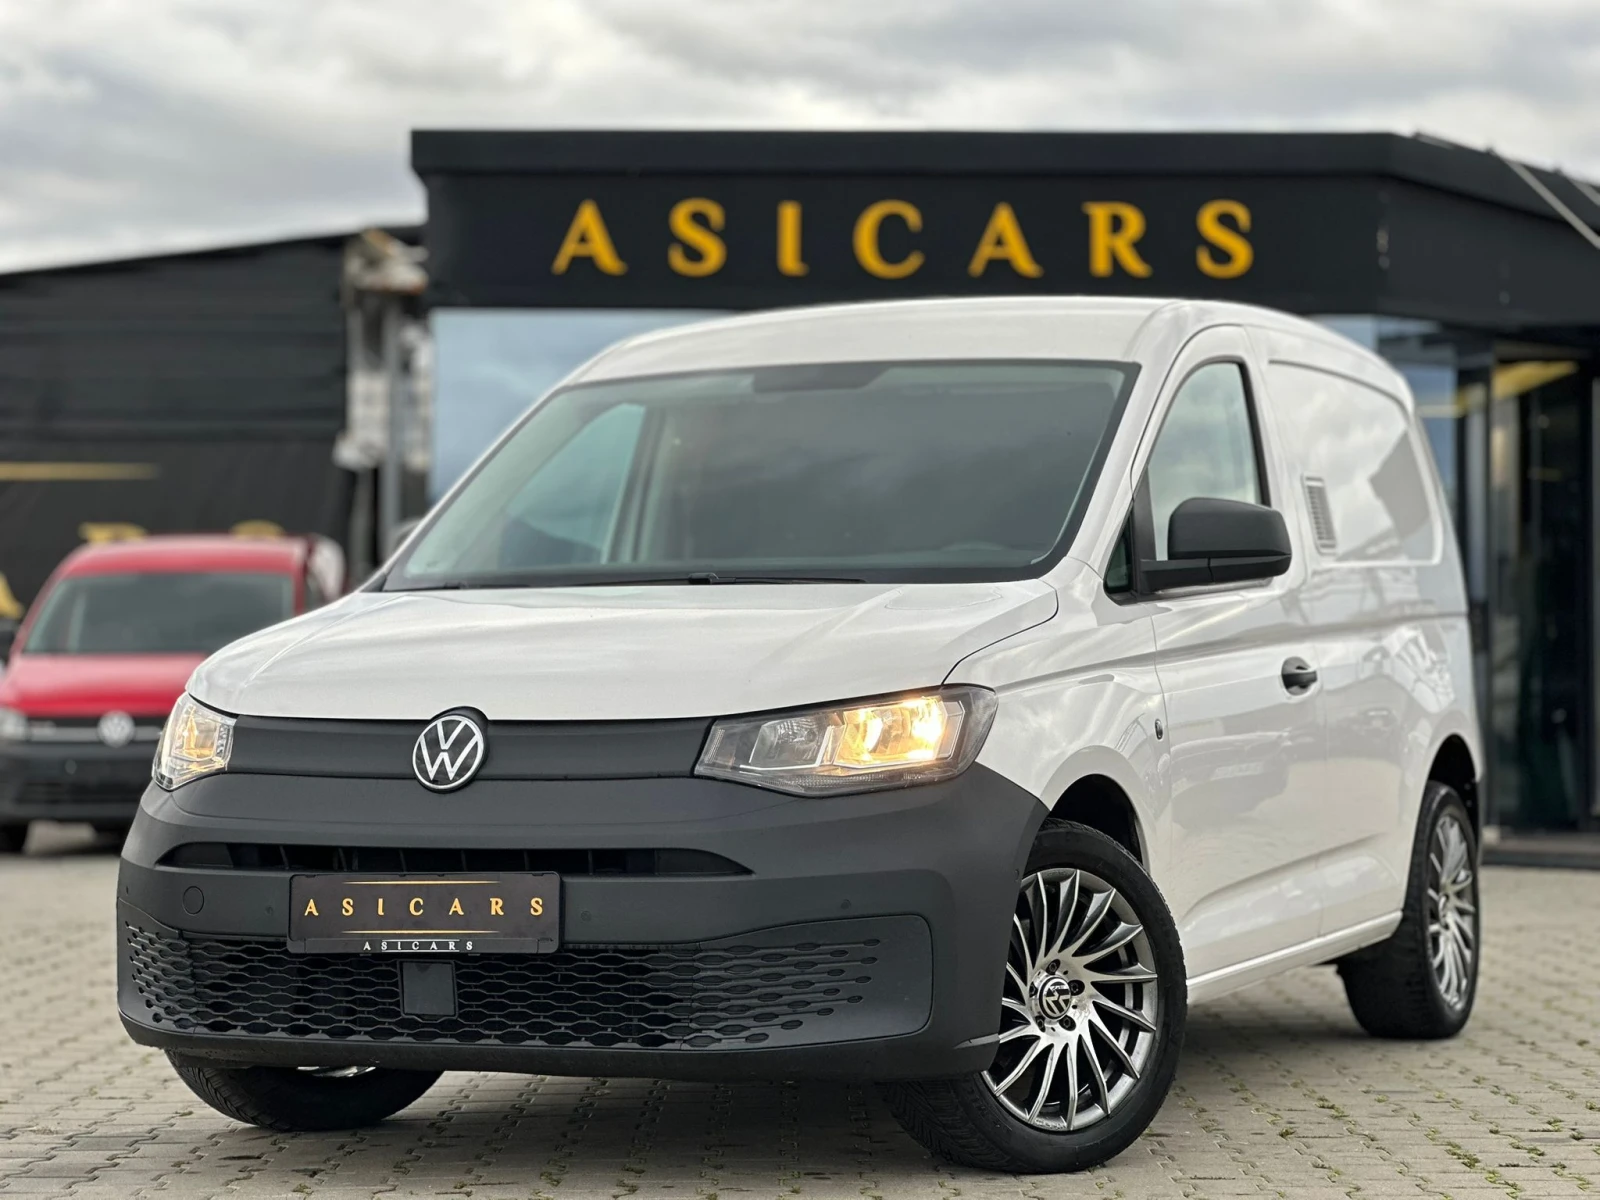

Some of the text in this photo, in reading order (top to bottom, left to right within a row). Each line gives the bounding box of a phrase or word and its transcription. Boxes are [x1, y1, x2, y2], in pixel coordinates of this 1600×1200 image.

[552, 198, 1254, 278] ASICARS
[304, 897, 544, 916] ASICARS
[363, 941, 473, 951] ASICARS
